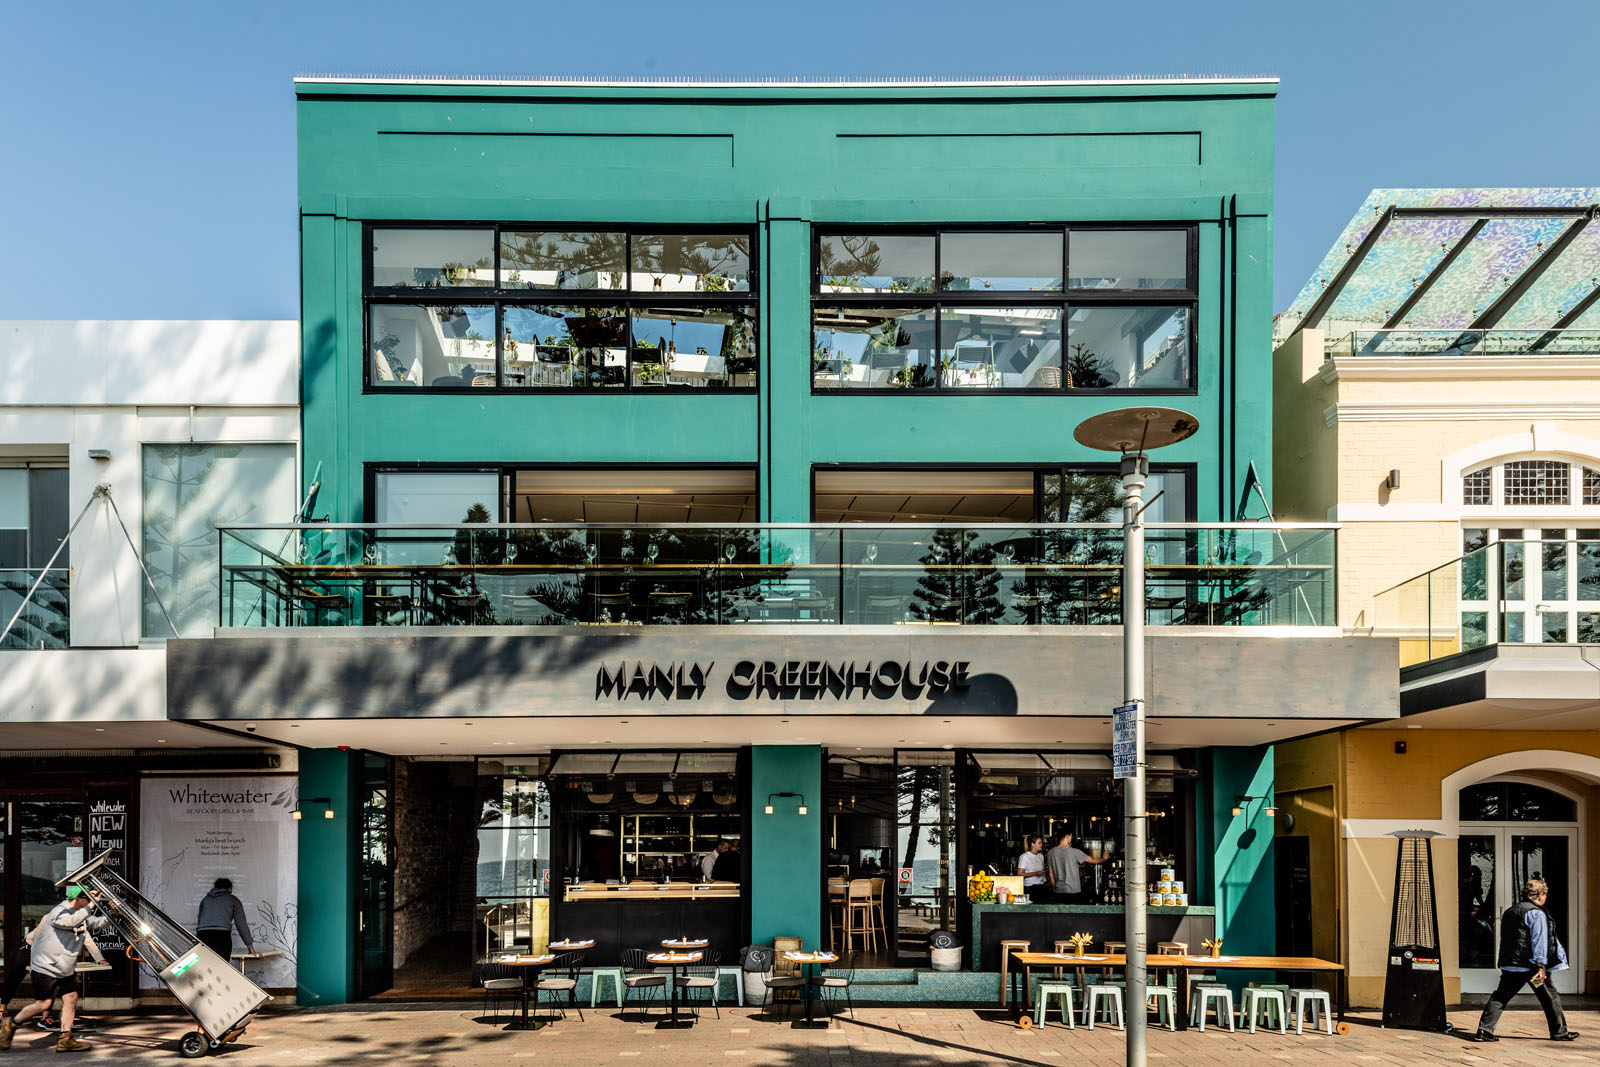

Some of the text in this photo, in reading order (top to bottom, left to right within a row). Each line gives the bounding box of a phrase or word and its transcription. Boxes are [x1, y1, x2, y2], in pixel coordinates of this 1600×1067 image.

[596, 660, 970, 698] MANLY GREENHOUSE
[1121, 755, 1126, 765] 22
[169, 783, 272, 804] Whitewater
[90, 800, 126, 813] whitewater
[91, 815, 124, 832] NEW
